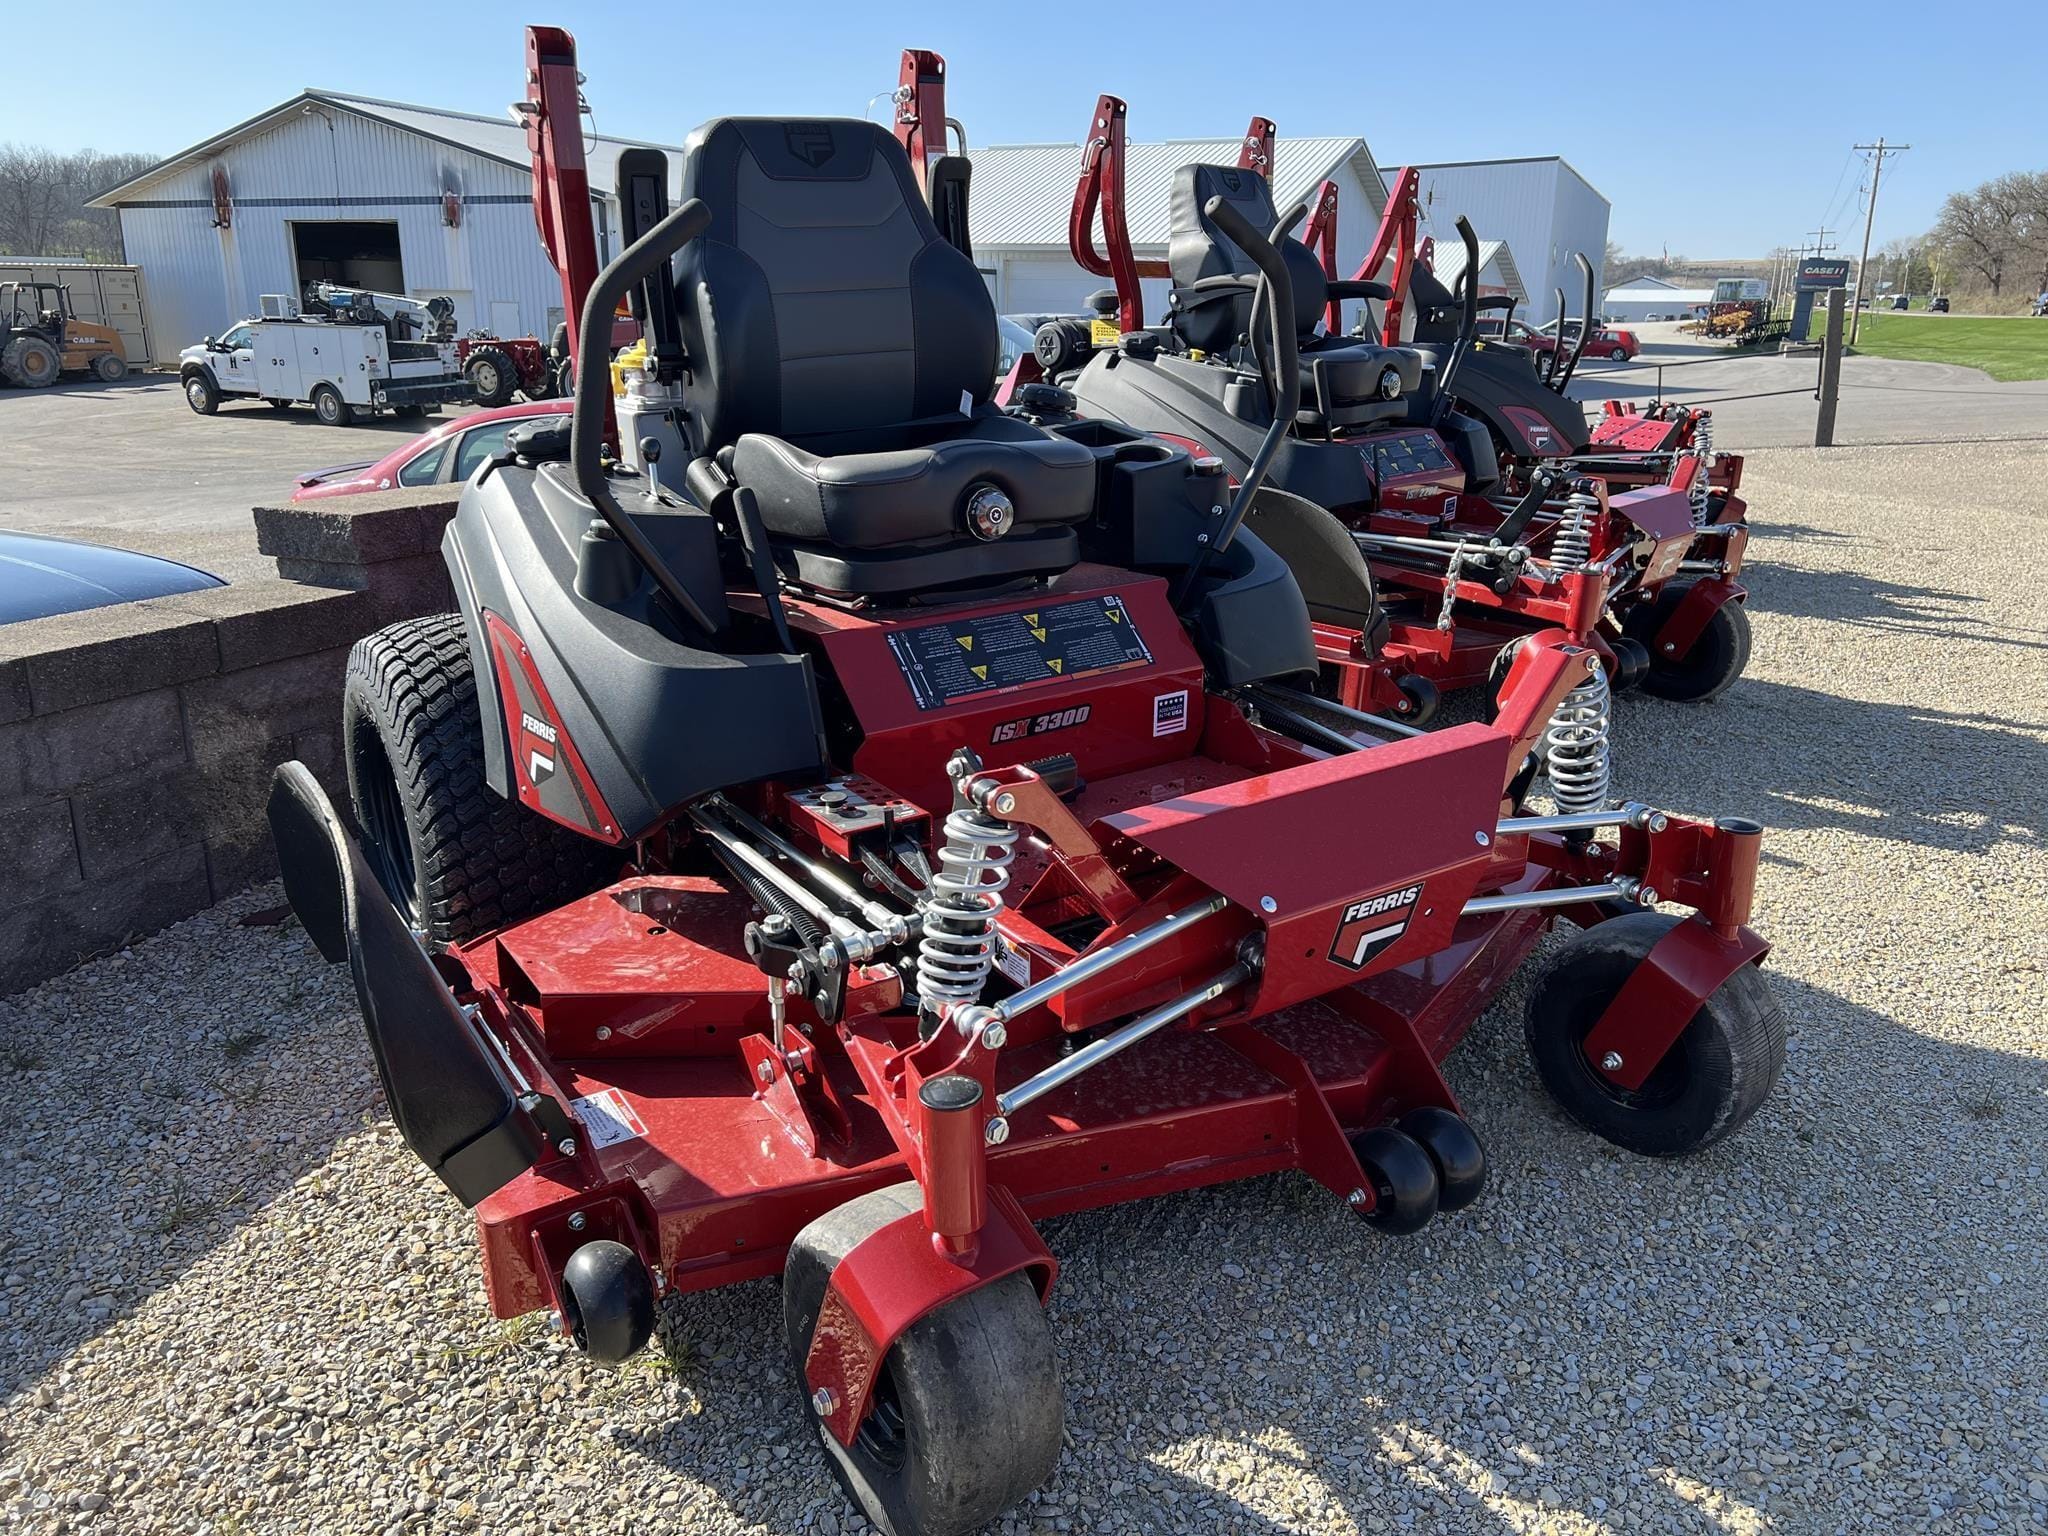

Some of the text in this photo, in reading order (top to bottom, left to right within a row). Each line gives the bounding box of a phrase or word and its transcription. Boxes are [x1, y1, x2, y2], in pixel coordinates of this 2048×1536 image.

[522, 713, 557, 743] FERRIS
[992, 706, 1091, 744] ISX 3300
[1171, 708, 1183, 716] USA
[1344, 887, 1418, 923] FERRIS
